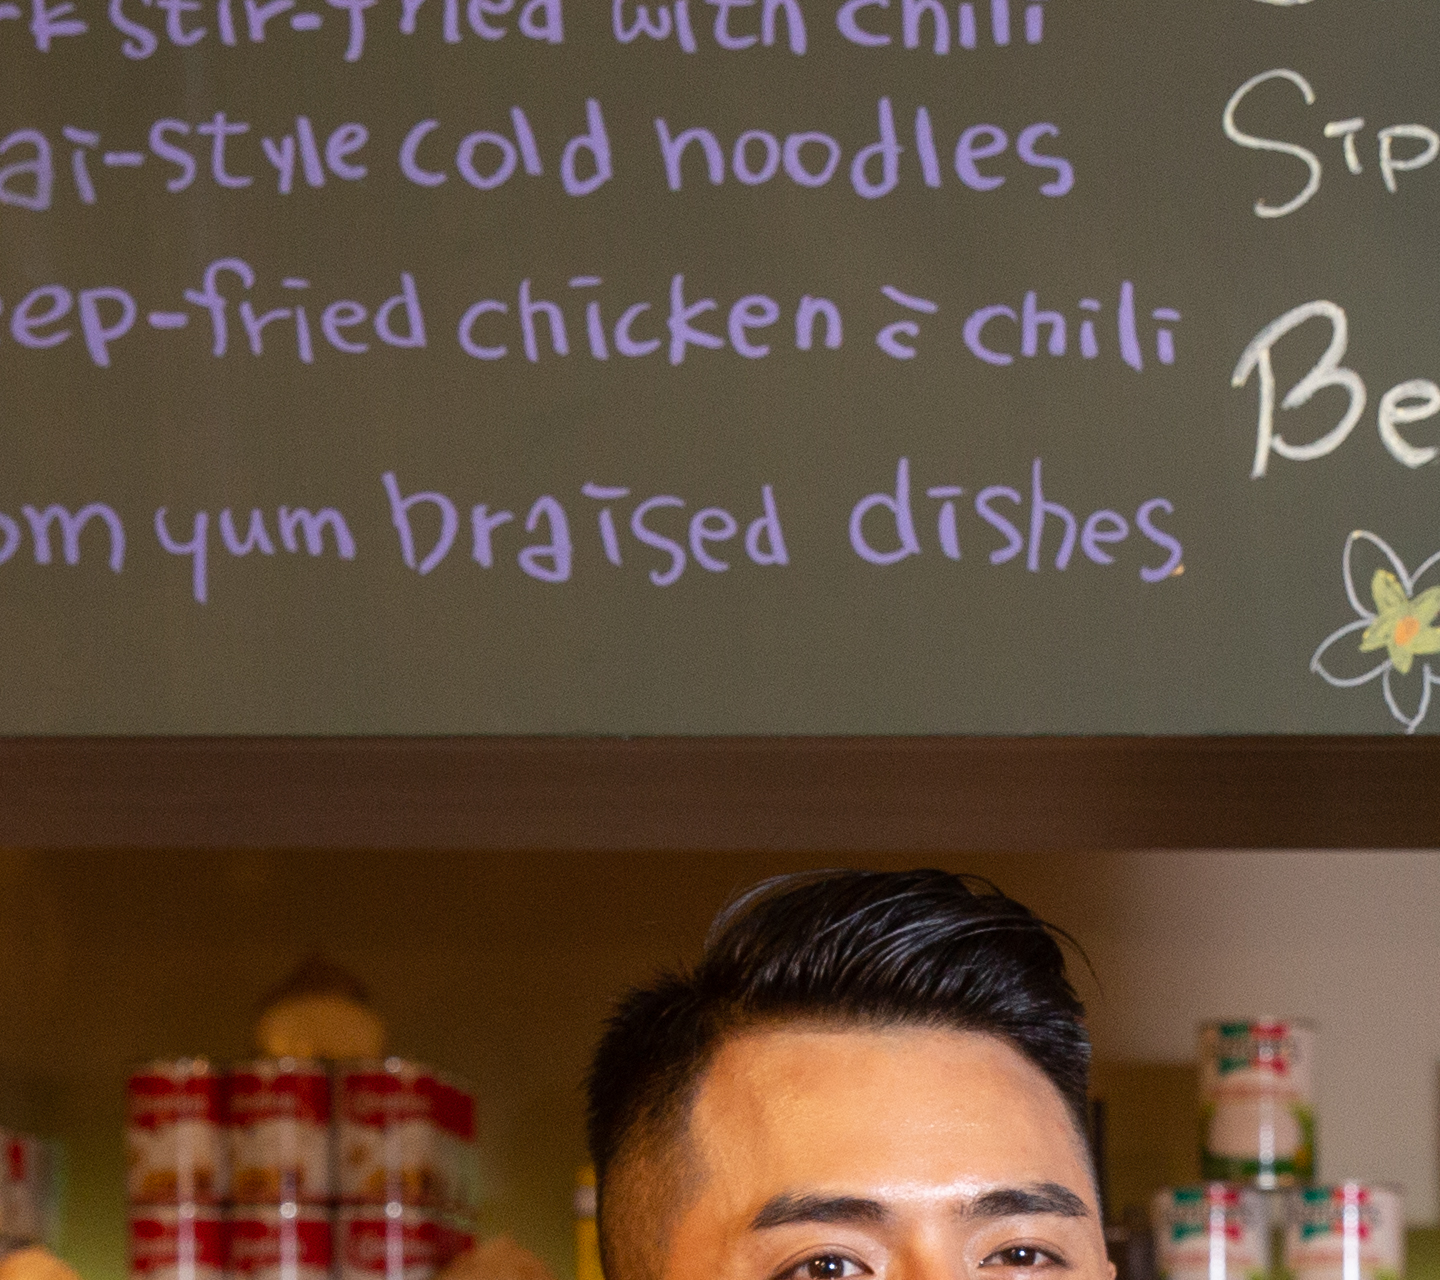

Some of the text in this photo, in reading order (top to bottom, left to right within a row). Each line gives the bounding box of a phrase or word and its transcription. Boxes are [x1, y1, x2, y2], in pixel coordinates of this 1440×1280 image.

[611, 0, 808, 55] with
[835, 0, 1044, 55] chili
[397, 97, 614, 198] cold
[654, 96, 1076, 201] noodles
[455, 273, 844, 366] chicken
[960, 279, 1181, 371] chili
[152, 505, 358, 604] yum
[380, 470, 791, 588] braised
[846, 456, 1185, 585] dishes
